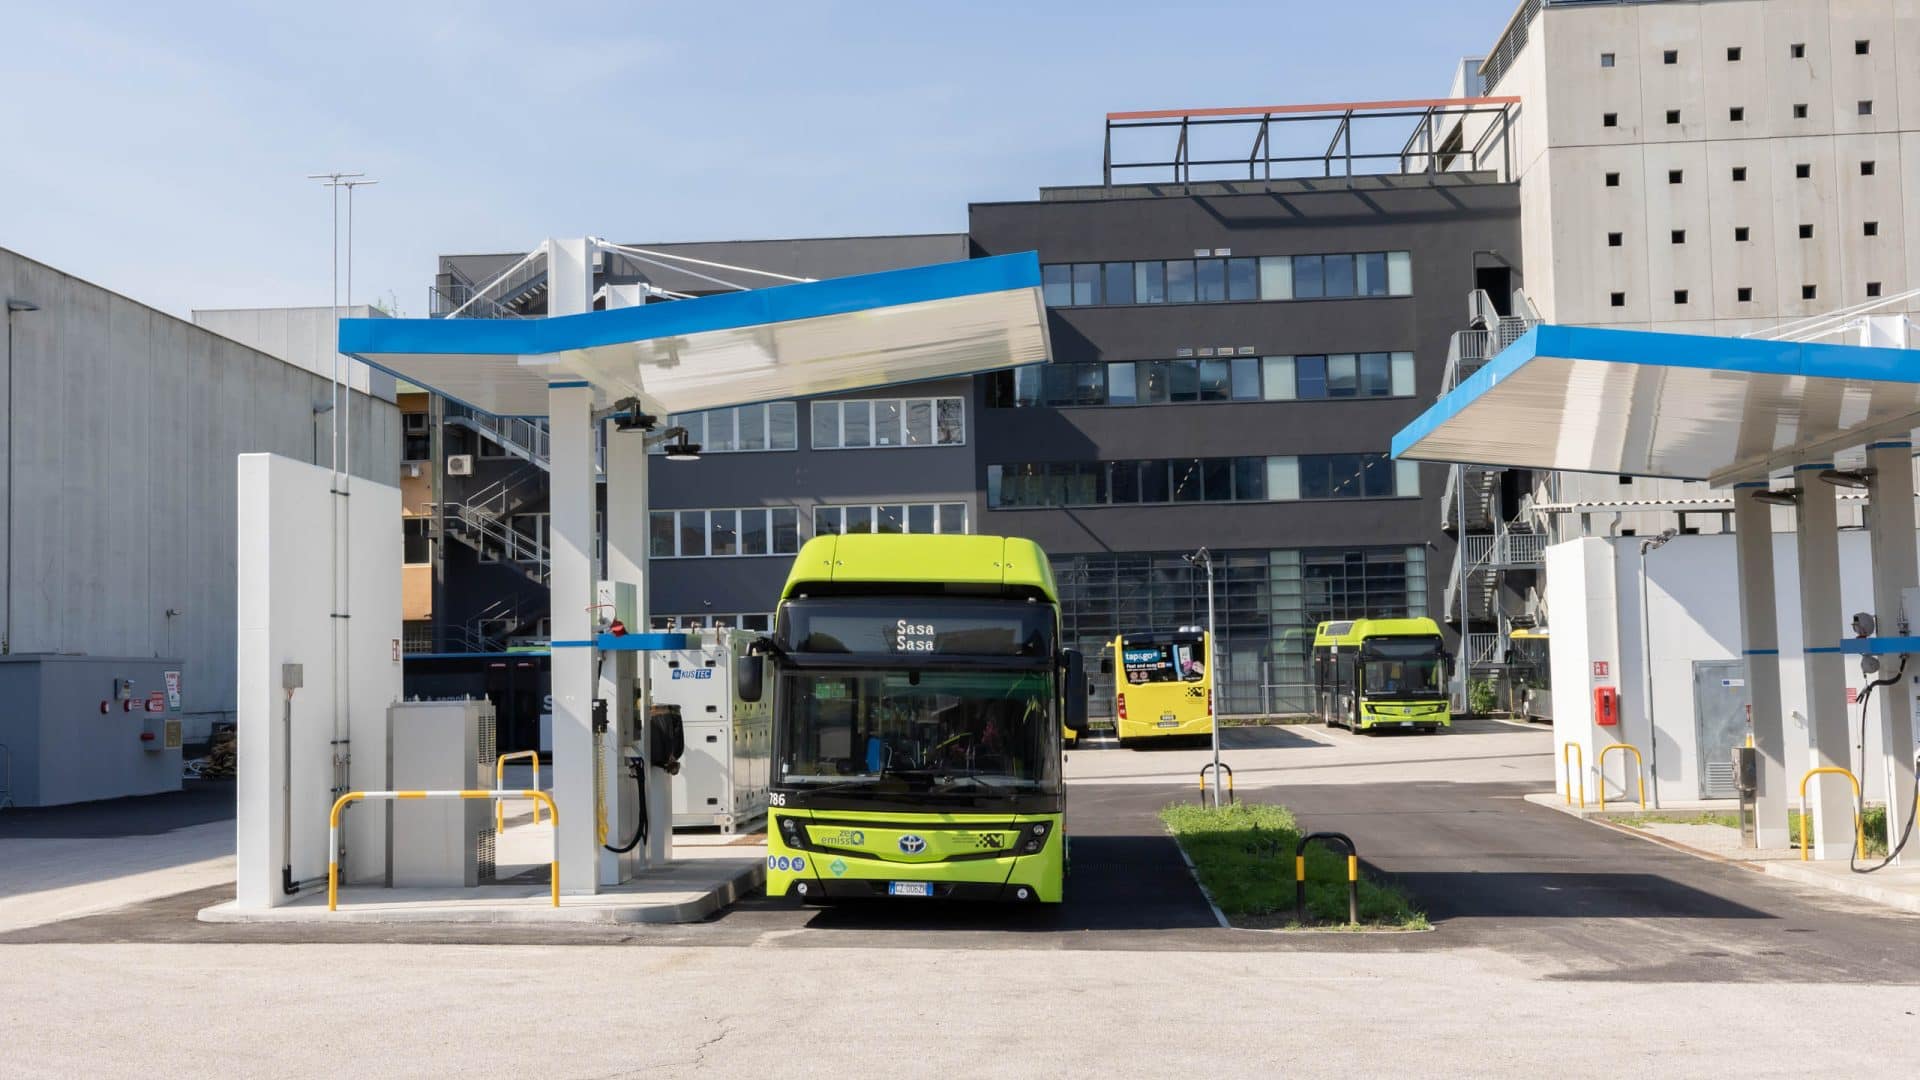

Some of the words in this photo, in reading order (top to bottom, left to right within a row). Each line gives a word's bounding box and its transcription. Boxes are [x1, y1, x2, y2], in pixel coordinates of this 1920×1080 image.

[897, 619, 934, 635] Sasa
[896, 635, 934, 651] Sasa
[682, 670, 712, 679] KUSTEC
[769, 792, 786, 806] 786
